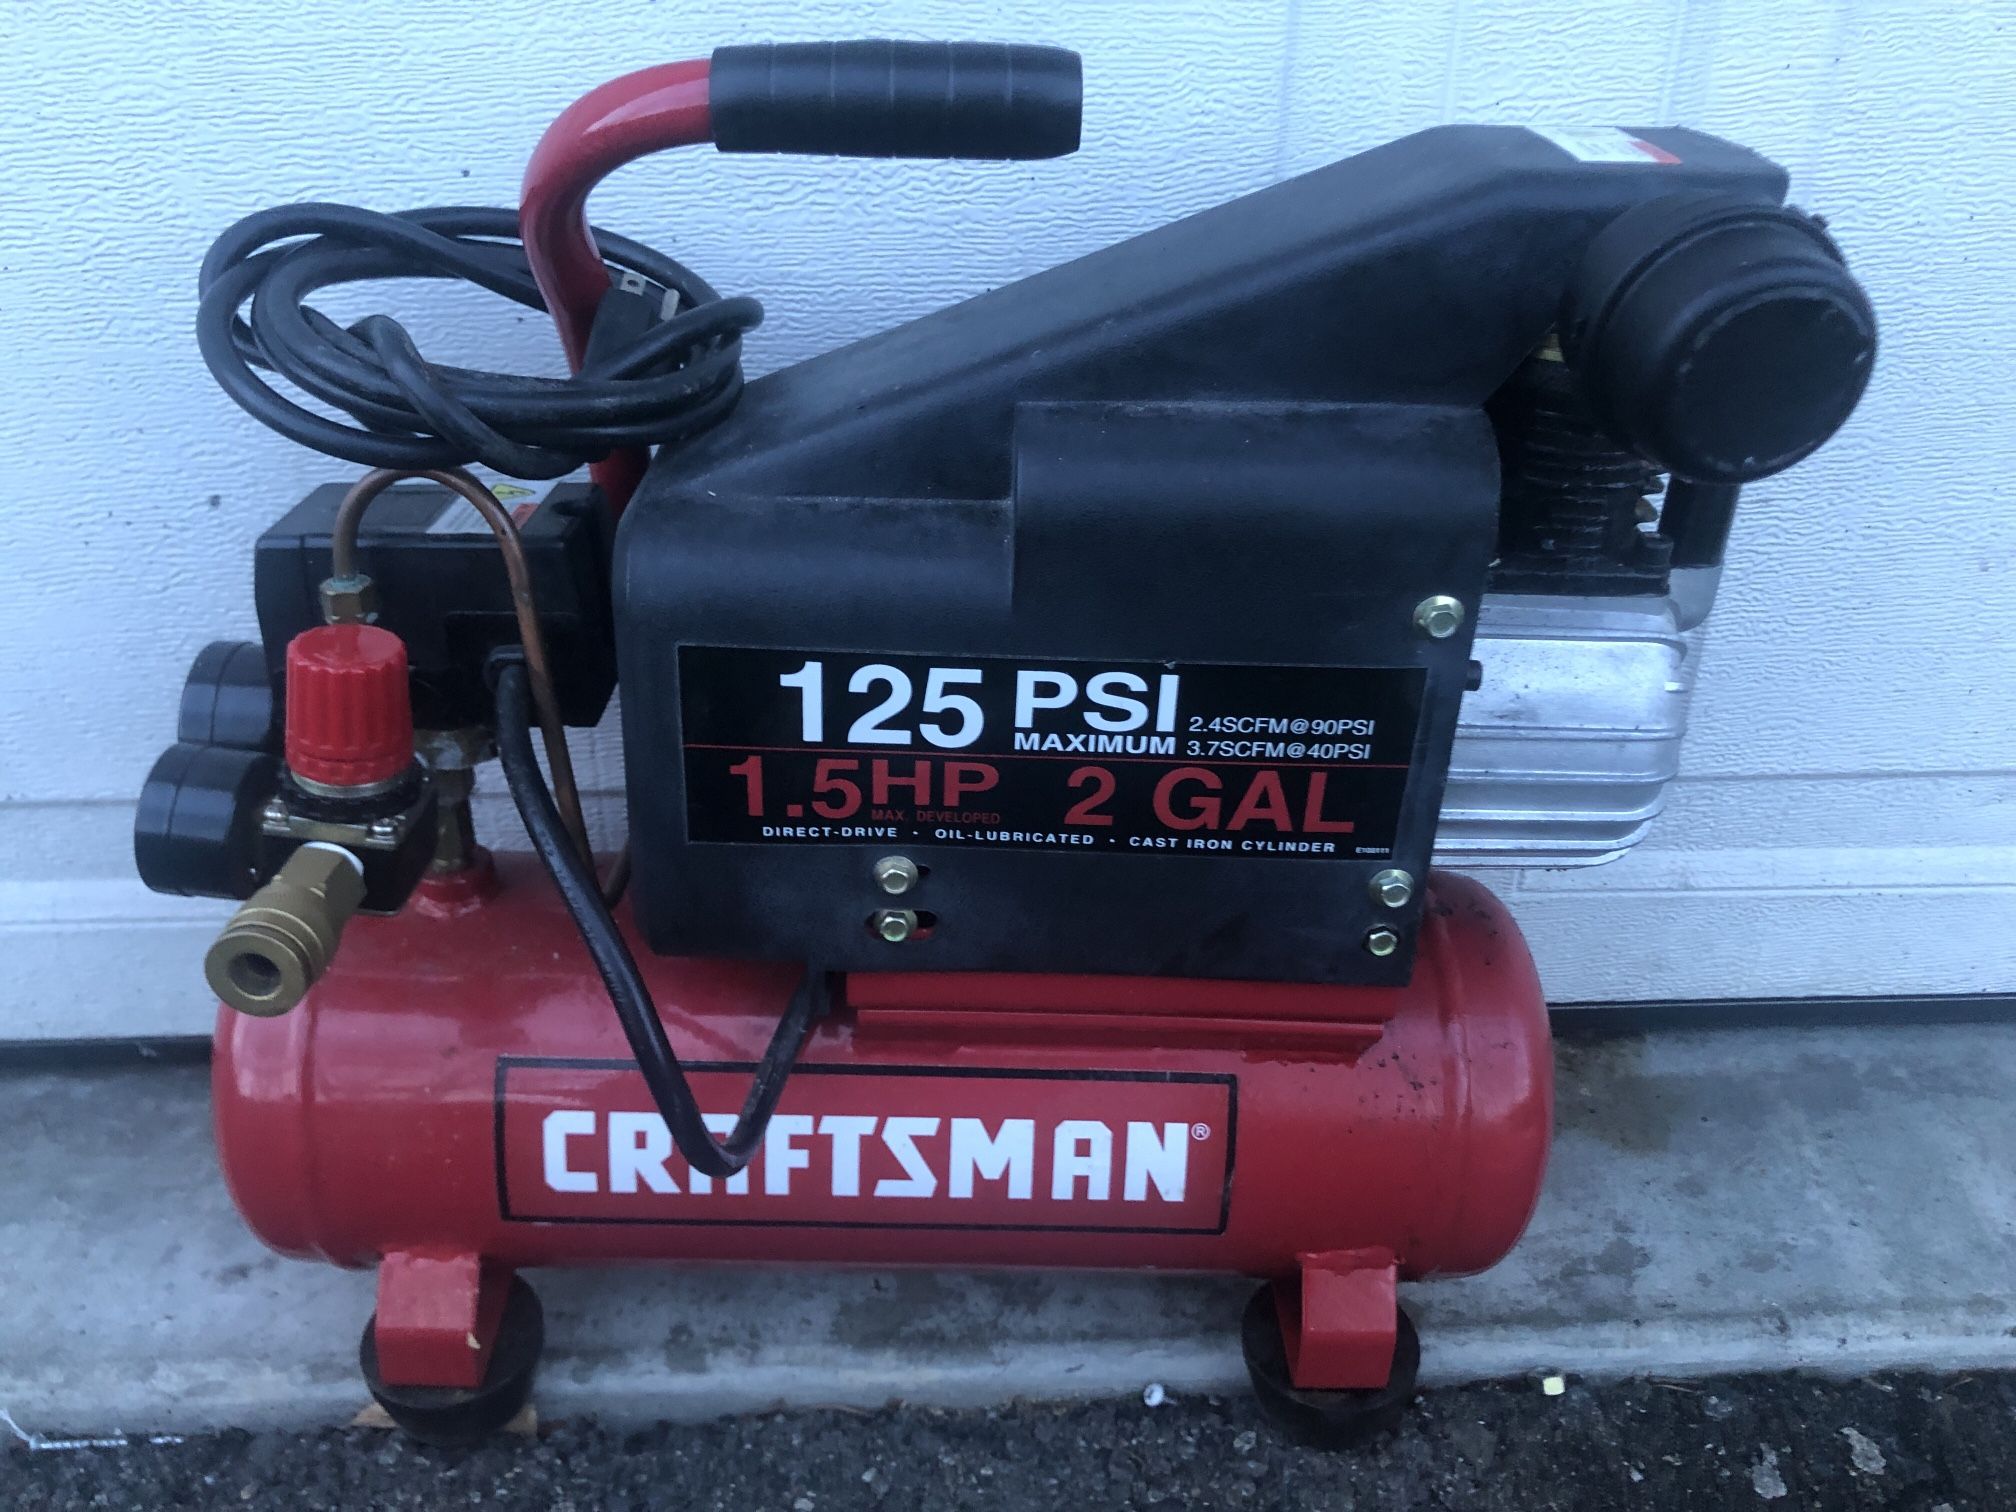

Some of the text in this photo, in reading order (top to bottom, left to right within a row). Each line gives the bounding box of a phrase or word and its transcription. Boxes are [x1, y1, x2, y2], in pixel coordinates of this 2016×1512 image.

[780, 661, 1180, 749] 125 PSI
[1188, 716, 1375, 736] 2.4SCFM@90PSI
[1014, 732, 1176, 755] MAXIMUM
[1186, 740, 1371, 760] 3.7SCFM@40PSI
[1064, 766, 1117, 826] 2
[1152, 767, 1354, 833] GAL
[916, 810, 1001, 824] DEVELOPED
[762, 826, 1336, 853] DIRECT-DRIVE OIL-LUBRICATED CAST IRON CYLINDER
